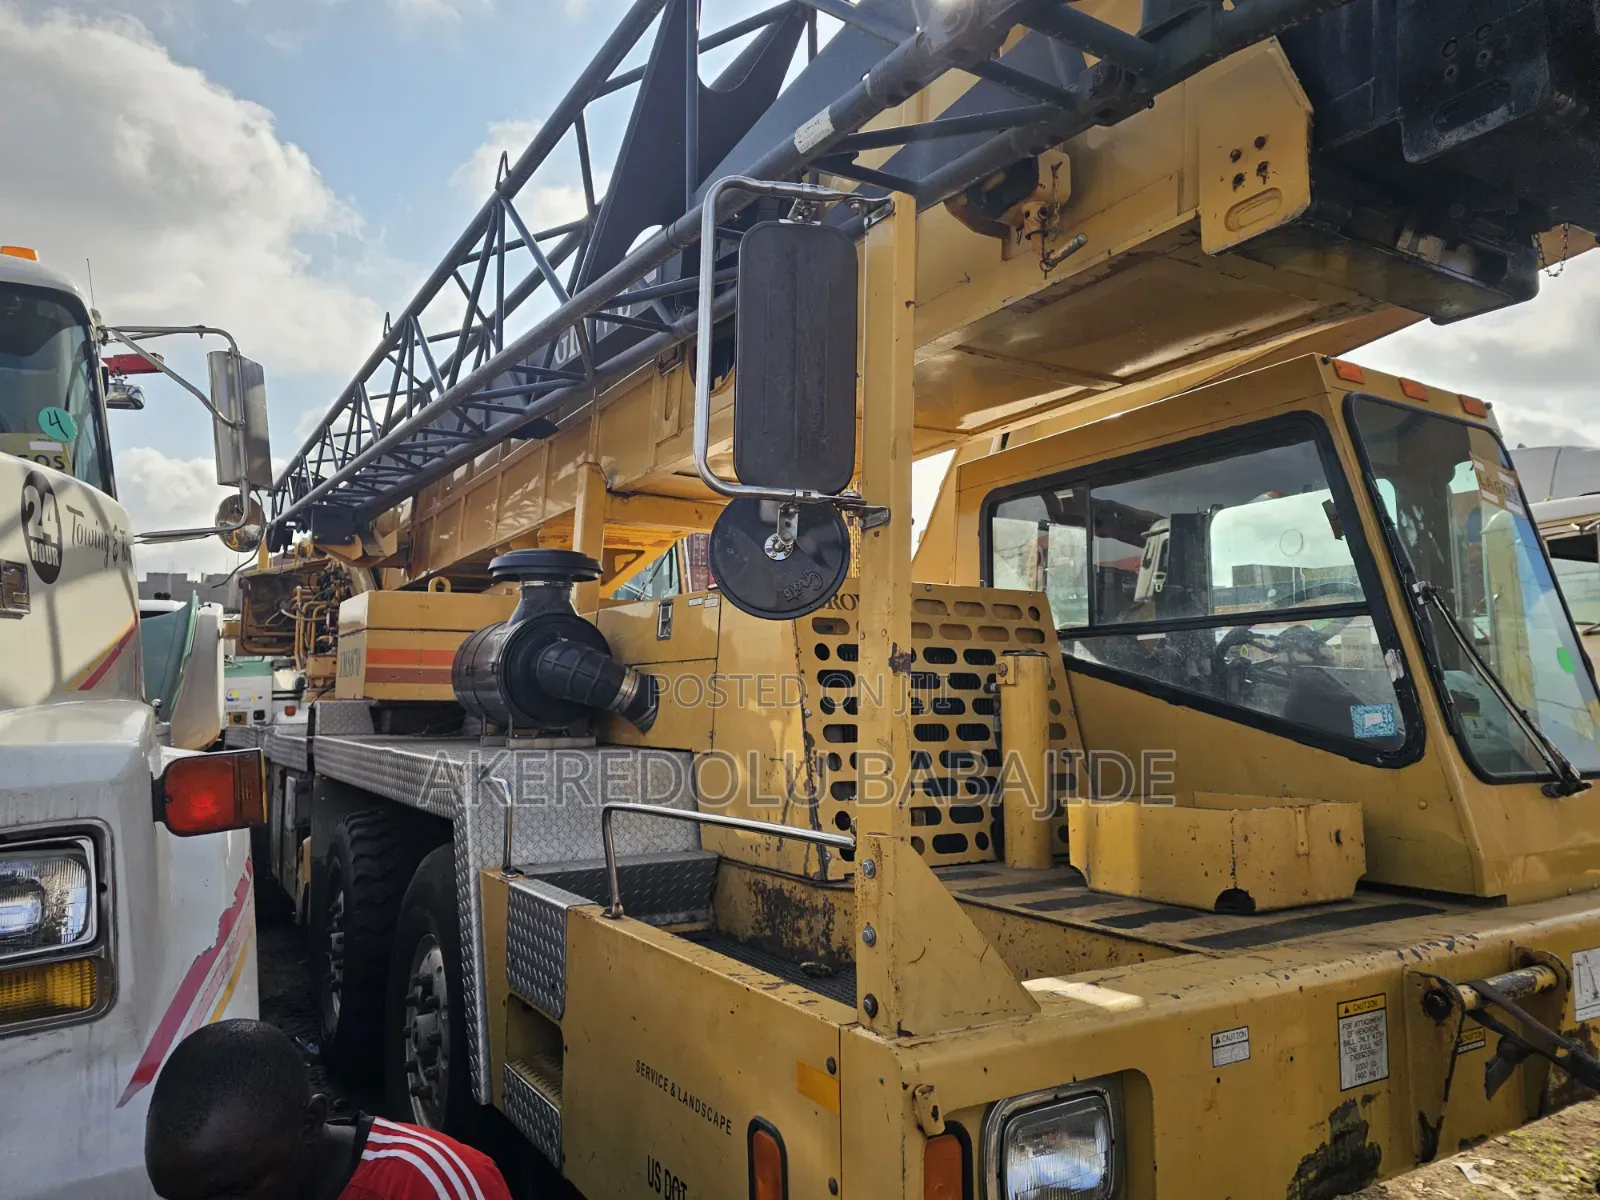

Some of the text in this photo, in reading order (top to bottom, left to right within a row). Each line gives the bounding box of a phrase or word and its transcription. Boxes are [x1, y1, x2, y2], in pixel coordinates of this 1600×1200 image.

[47, 410, 69, 439] 4
[17, 454, 66, 470] OS
[24, 485, 59, 545] 24
[66, 504, 109, 568] Towing
[30, 539, 60, 567] HOUR
[1353, 1000, 1377, 1011] CAUTION
[1221, 1031, 1247, 1043] CAUTION
[635, 1059, 732, 1136] SERVICE & LANDSCAPE
[647, 1154, 688, 1200] US DOT
